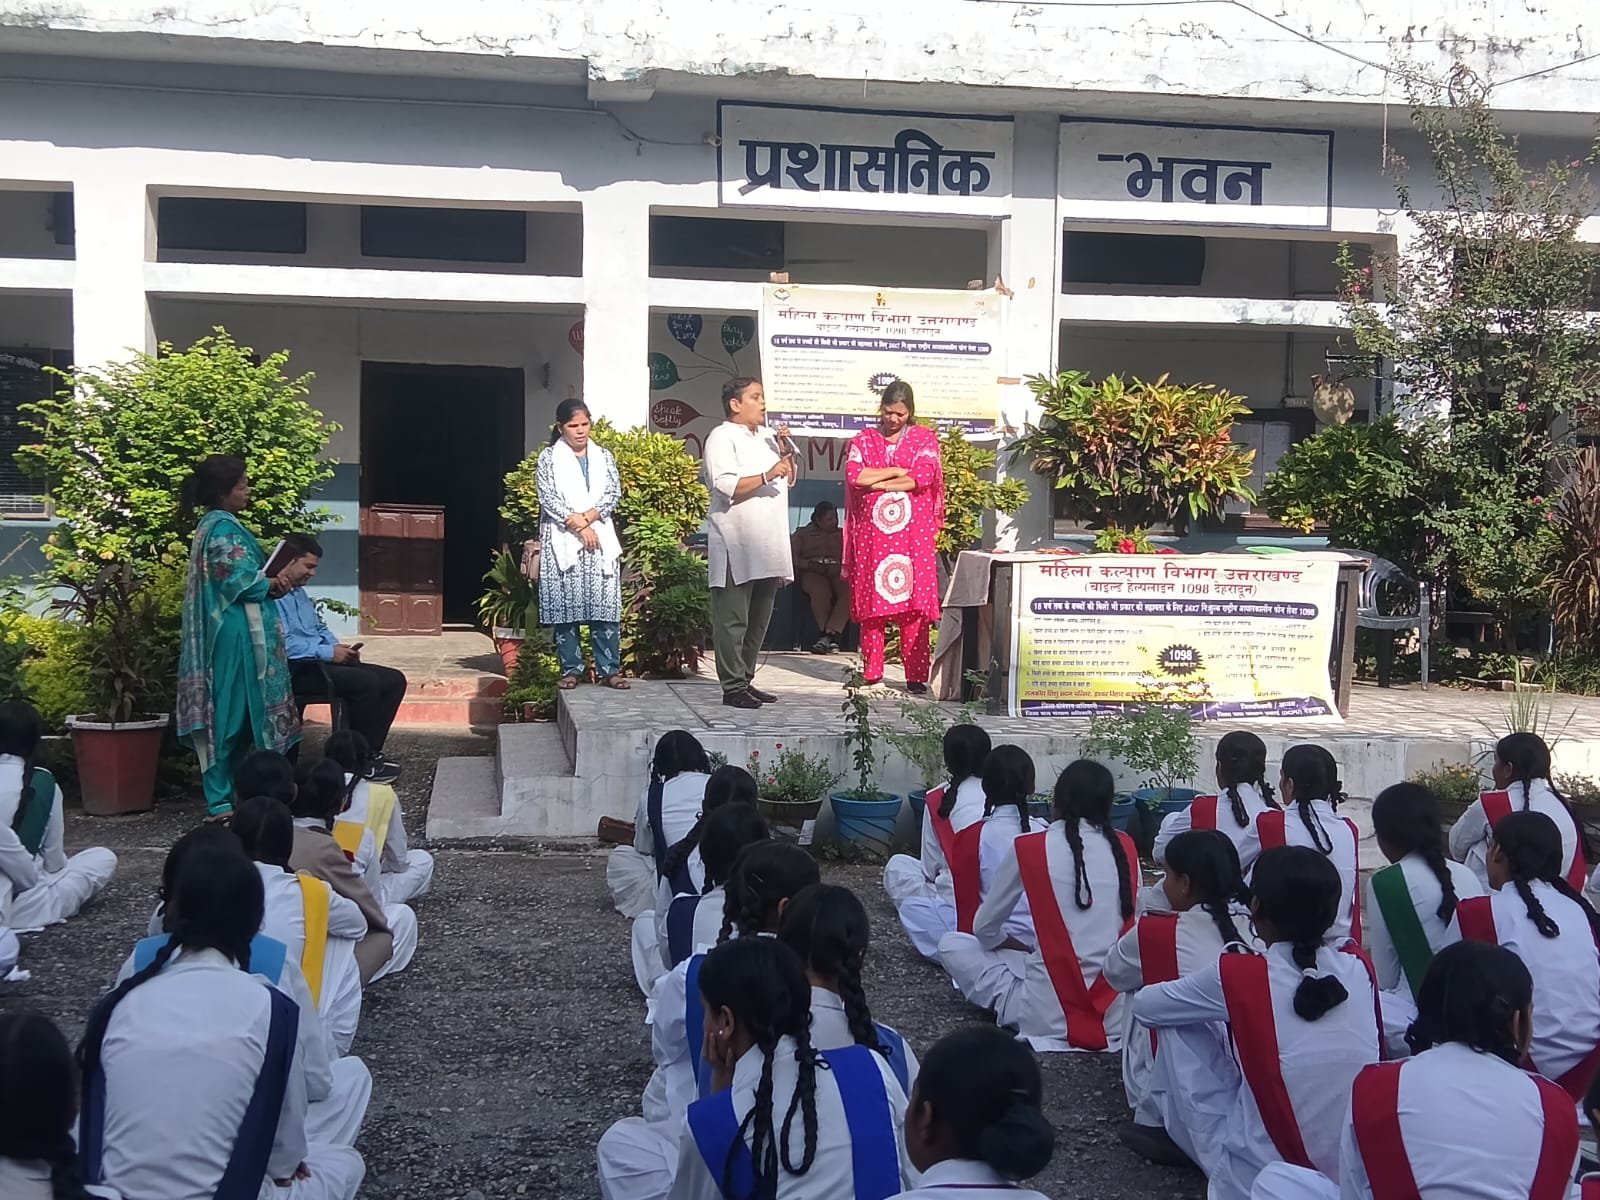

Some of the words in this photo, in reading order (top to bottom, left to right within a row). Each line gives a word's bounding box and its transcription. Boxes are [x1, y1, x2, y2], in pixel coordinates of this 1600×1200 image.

[738, 128, 996, 198] प्रशासनिक
[1097, 151, 1272, 206] भवन
[1039, 562, 1091, 578] महिला
[1099, 566, 1156, 579] कल्याण
[1163, 562, 1217, 580] विभाग
[1223, 567, 1303, 584] उत्तराखण्ड
[1181, 583, 1210, 594] 1098
[1169, 649, 1192, 661] 1098
